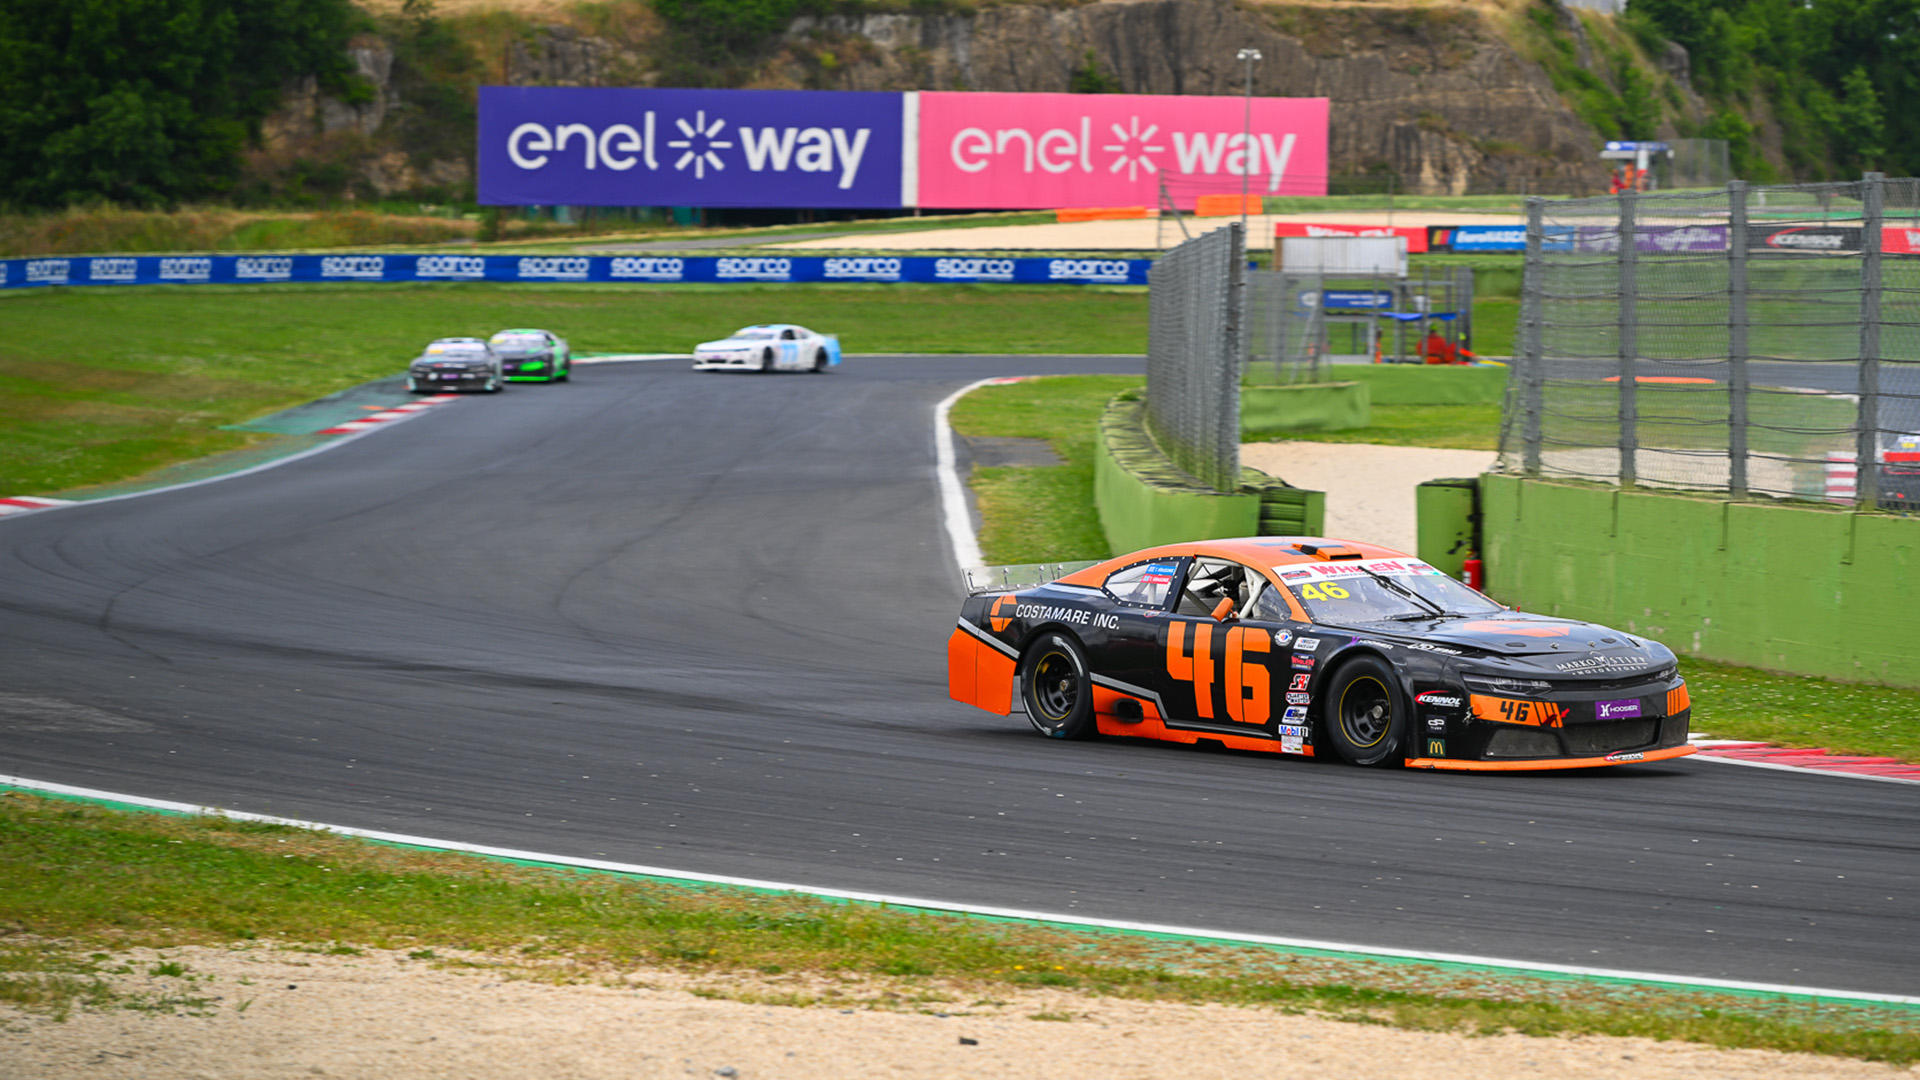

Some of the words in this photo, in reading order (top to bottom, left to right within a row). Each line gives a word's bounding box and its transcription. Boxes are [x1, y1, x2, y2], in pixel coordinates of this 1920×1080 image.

[507, 111, 659, 171] enel
[738, 126, 871, 189] way
[951, 116, 1093, 173] enel
[1172, 131, 1297, 192] way
[321, 257, 384, 272] sparco
[416, 256, 485, 272] sparco
[517, 257, 590, 272] sparco
[610, 257, 684, 273] sparco
[716, 257, 791, 273] sparco
[824, 258, 901, 273] sparco
[934, 258, 1015, 273] sparco
[1049, 259, 1130, 275] sparco
[1302, 581, 1350, 601] 46
[1016, 604, 1091, 625] COSTAMARE
[1093, 613, 1120, 630] INC.
[1166, 621, 1271, 725] 46
[1556, 659, 1596, 671] MARKO
[1418, 695, 1461, 705] KENNOL
[1500, 701, 1530, 721] 46
[1610, 704, 1638, 713] HOOSIER
[1280, 726, 1299, 736] Mobil
